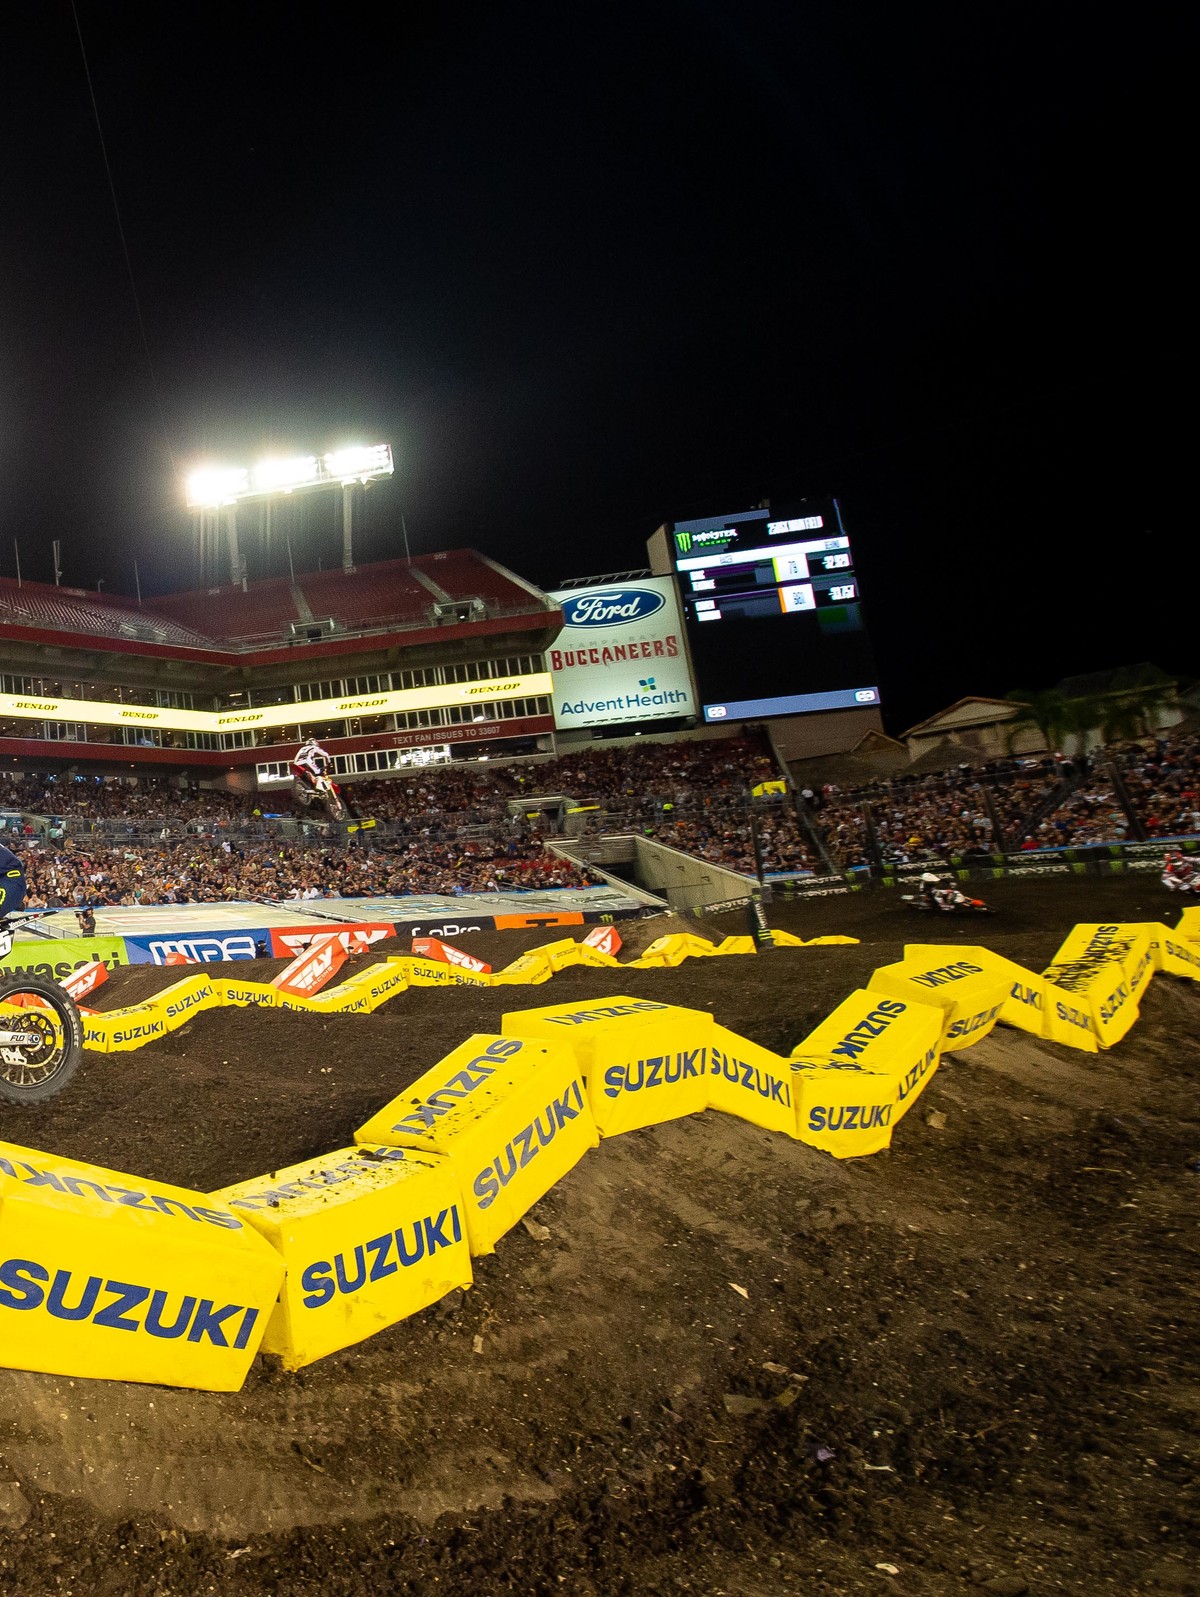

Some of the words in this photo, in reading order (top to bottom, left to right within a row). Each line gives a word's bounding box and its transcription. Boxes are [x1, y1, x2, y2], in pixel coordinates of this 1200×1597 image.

[571, 593, 642, 624] Ford
[550, 634, 680, 672] BUCCANEERS
[468, 683, 521, 695] DUNLOP
[16, 702, 58, 711] DUNLOP
[121, 711, 159, 720] DUNLOP
[339, 699, 388, 710] DUNLOP
[218, 713, 264, 725] DUNLOP
[392, 736, 413, 745] TEXT
[415, 734, 432, 742] FAN
[433, 730, 464, 740] ISSUES
[465, 728, 477, 736] TO
[287, 945, 333, 988] FLY
[413, 967, 447, 980] SUZUKI
[910, 961, 984, 988] SUZUKI
[227, 989, 273, 1005] SUZUKI
[371, 973, 406, 998] SUZUKI
[166, 985, 213, 1018] SUZUKI
[543, 1000, 671, 1025] SUZUKI
[113, 1020, 164, 1043] SUZUKI
[604, 1047, 707, 1098] SUZUKI
[710, 1046, 792, 1108] SUZUKI
[391, 1038, 524, 1136] SUZUKI
[808, 1103, 893, 1132] SUZUKI
[473, 1079, 585, 1210] SUZUKI
[301, 1204, 462, 1310] SUZUKI
